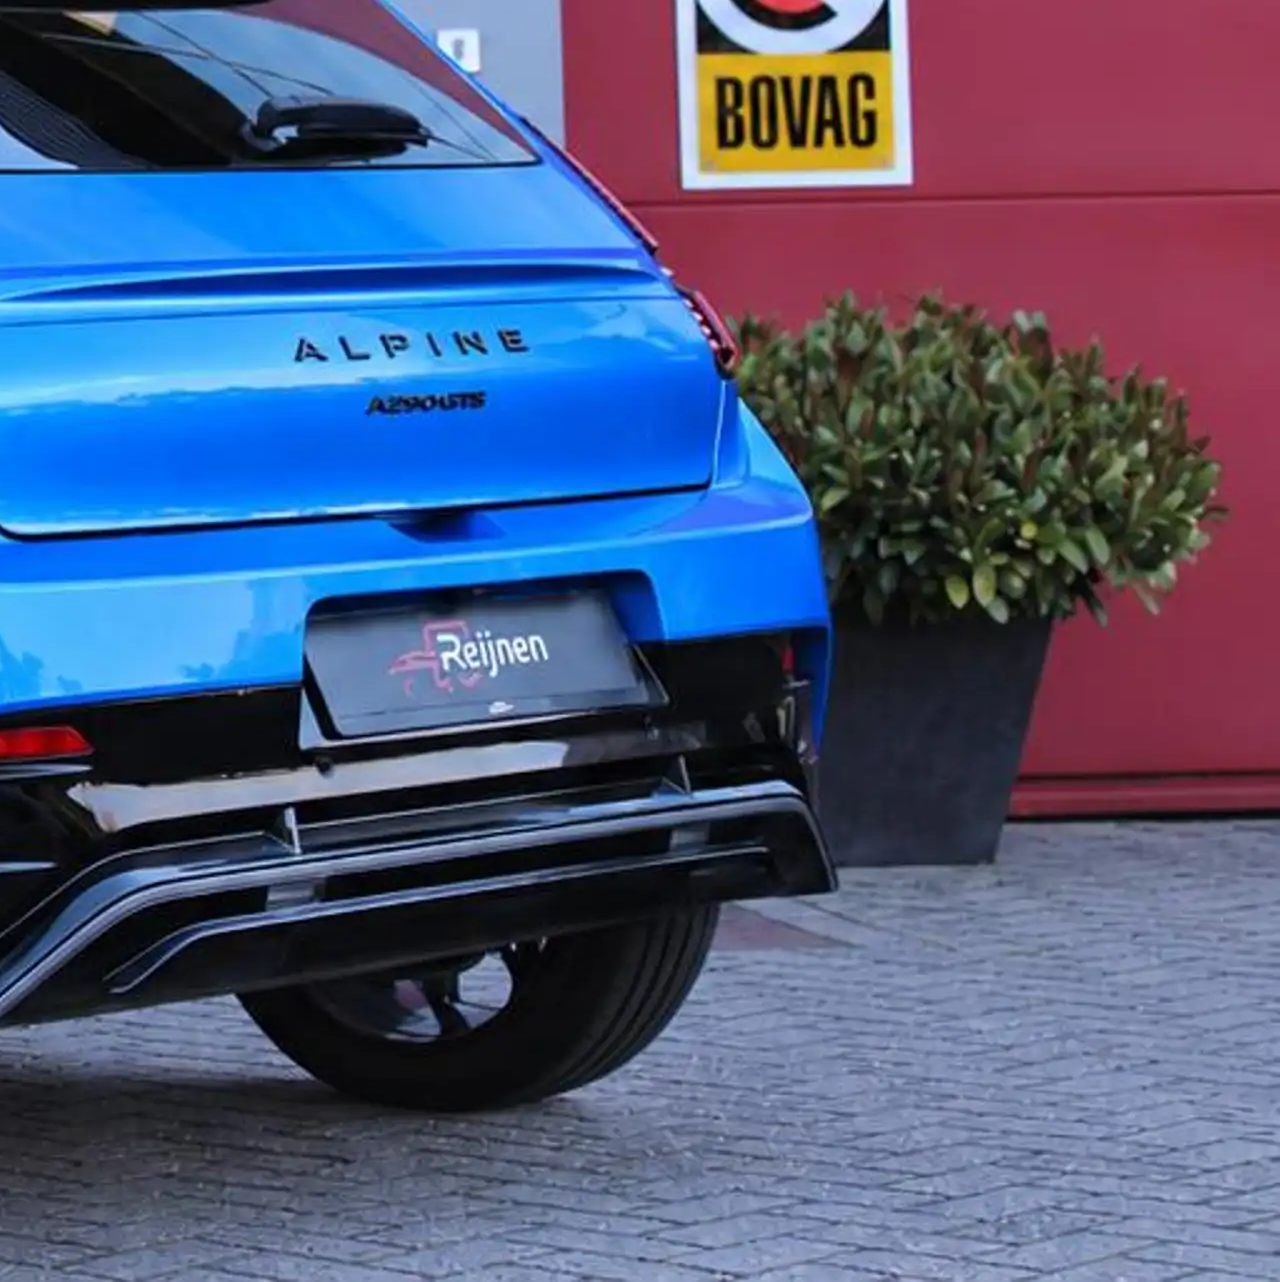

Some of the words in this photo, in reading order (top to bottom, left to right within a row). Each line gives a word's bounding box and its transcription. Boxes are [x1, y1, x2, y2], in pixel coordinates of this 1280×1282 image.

[716, 72, 877, 150] BOVAG
[294, 329, 530, 362] ALPINE
[437, 631, 549, 678] Reijnen
